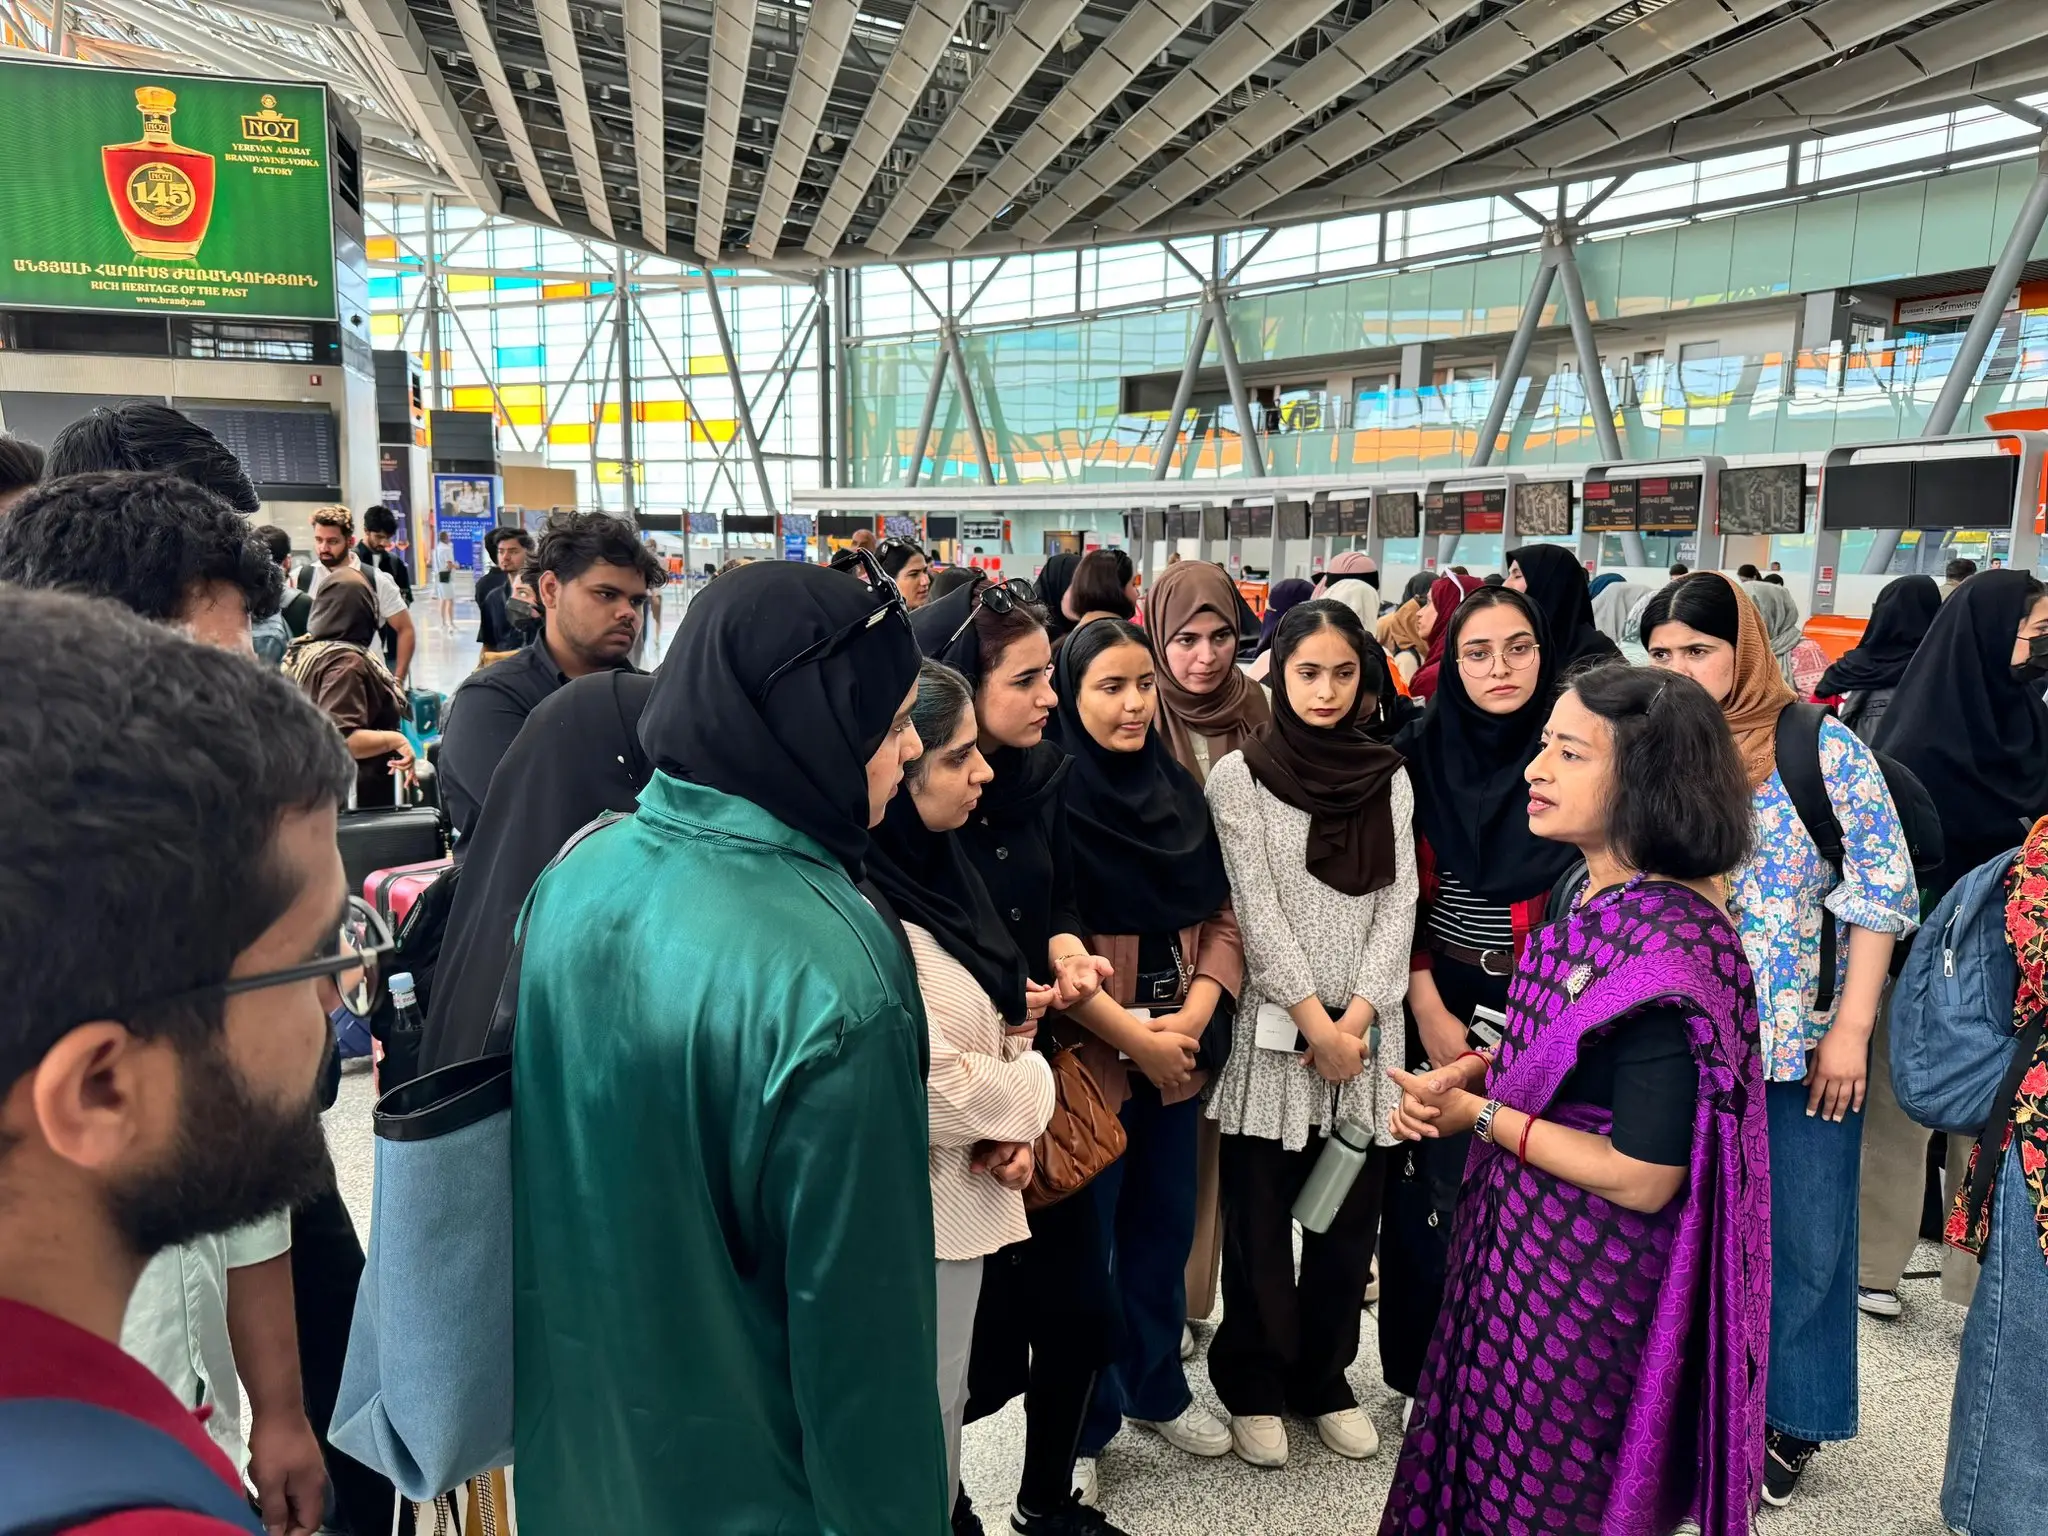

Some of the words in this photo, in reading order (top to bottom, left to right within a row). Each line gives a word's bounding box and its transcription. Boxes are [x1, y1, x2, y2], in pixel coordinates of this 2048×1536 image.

[248, 120, 293, 137] NOY
[231, 143, 273, 153] YEREVAN
[276, 146, 311, 156] ARARAT
[224, 153, 320, 167] BRANDY-WINE-VODKA
[252, 166, 294, 176] FACTORY
[132, 181, 191, 207] 145
[13, 259, 92, 275] ԱՆՑՅԱԼԻ
[94, 263, 169, 279] ՀԱՐՈՒՍՏ
[91, 280, 120, 291] RICH
[121, 282, 179, 294] HERITAGE
[180, 285, 196, 294] OF
[197, 286, 221, 296] THE
[221, 287, 249, 298] PAST
[136, 296, 206, 307] www.brandy.am
